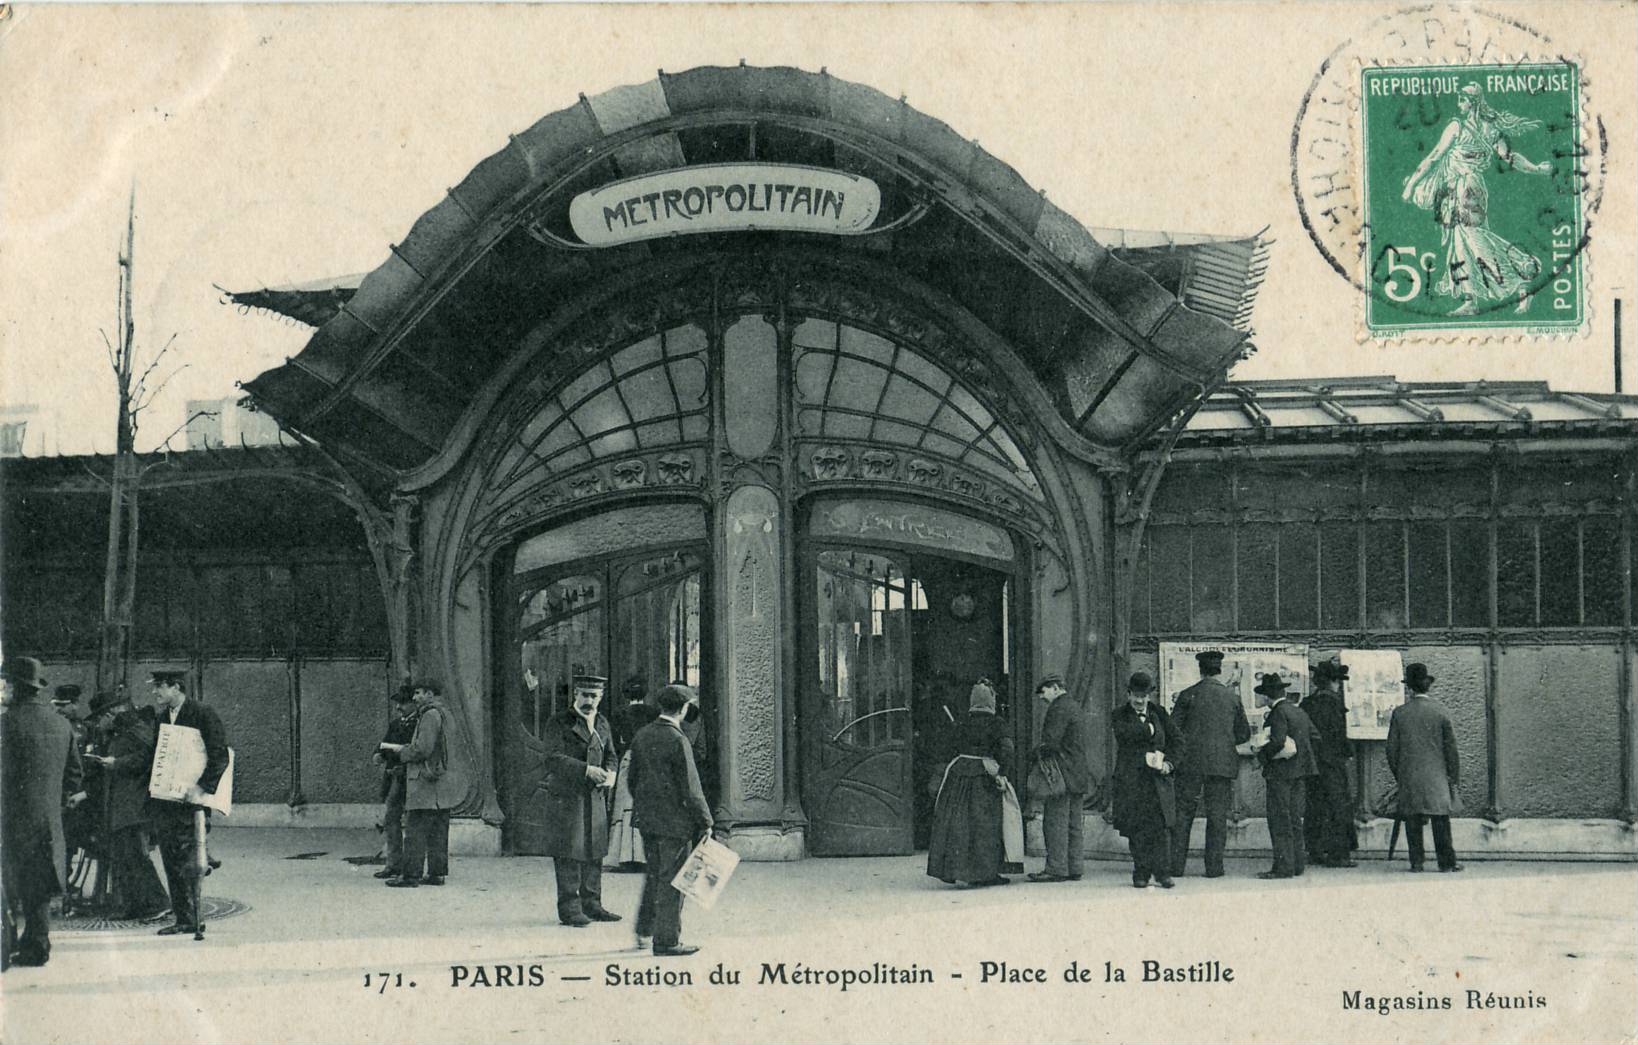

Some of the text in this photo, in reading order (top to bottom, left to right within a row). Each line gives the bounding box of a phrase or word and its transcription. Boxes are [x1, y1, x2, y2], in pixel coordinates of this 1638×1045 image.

[1486, 73, 1569, 96] FRANÇAISE
[602, 183, 846, 232] METROPOLITAIN
[1552, 224, 1572, 310] POSTES
